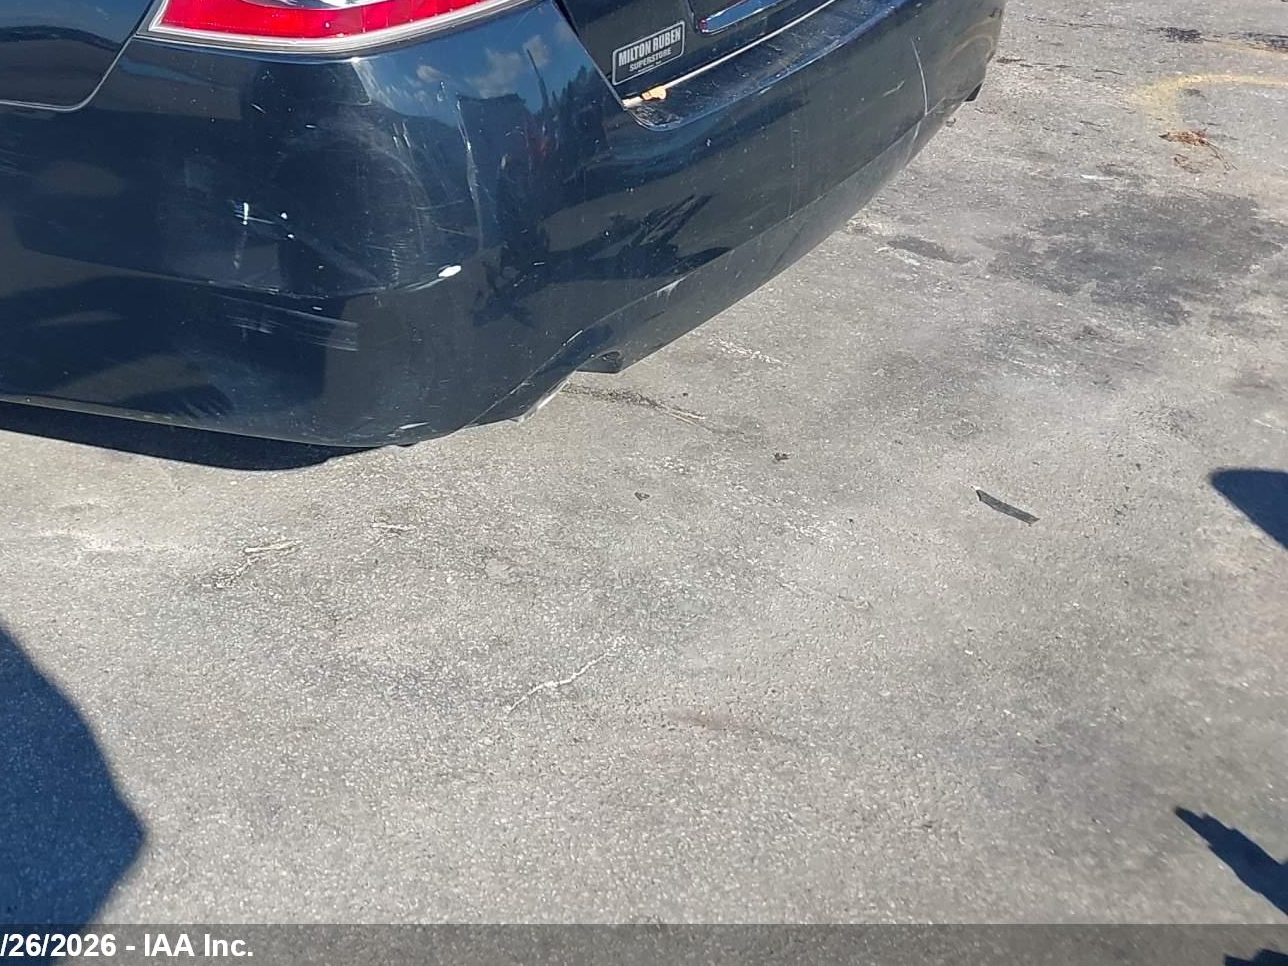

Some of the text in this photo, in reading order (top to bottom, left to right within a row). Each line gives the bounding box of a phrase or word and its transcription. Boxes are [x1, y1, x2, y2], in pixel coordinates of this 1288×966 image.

[618, 26, 682, 66] MILTON RUBEN
[629, 47, 672, 71] SUPERSTORE
